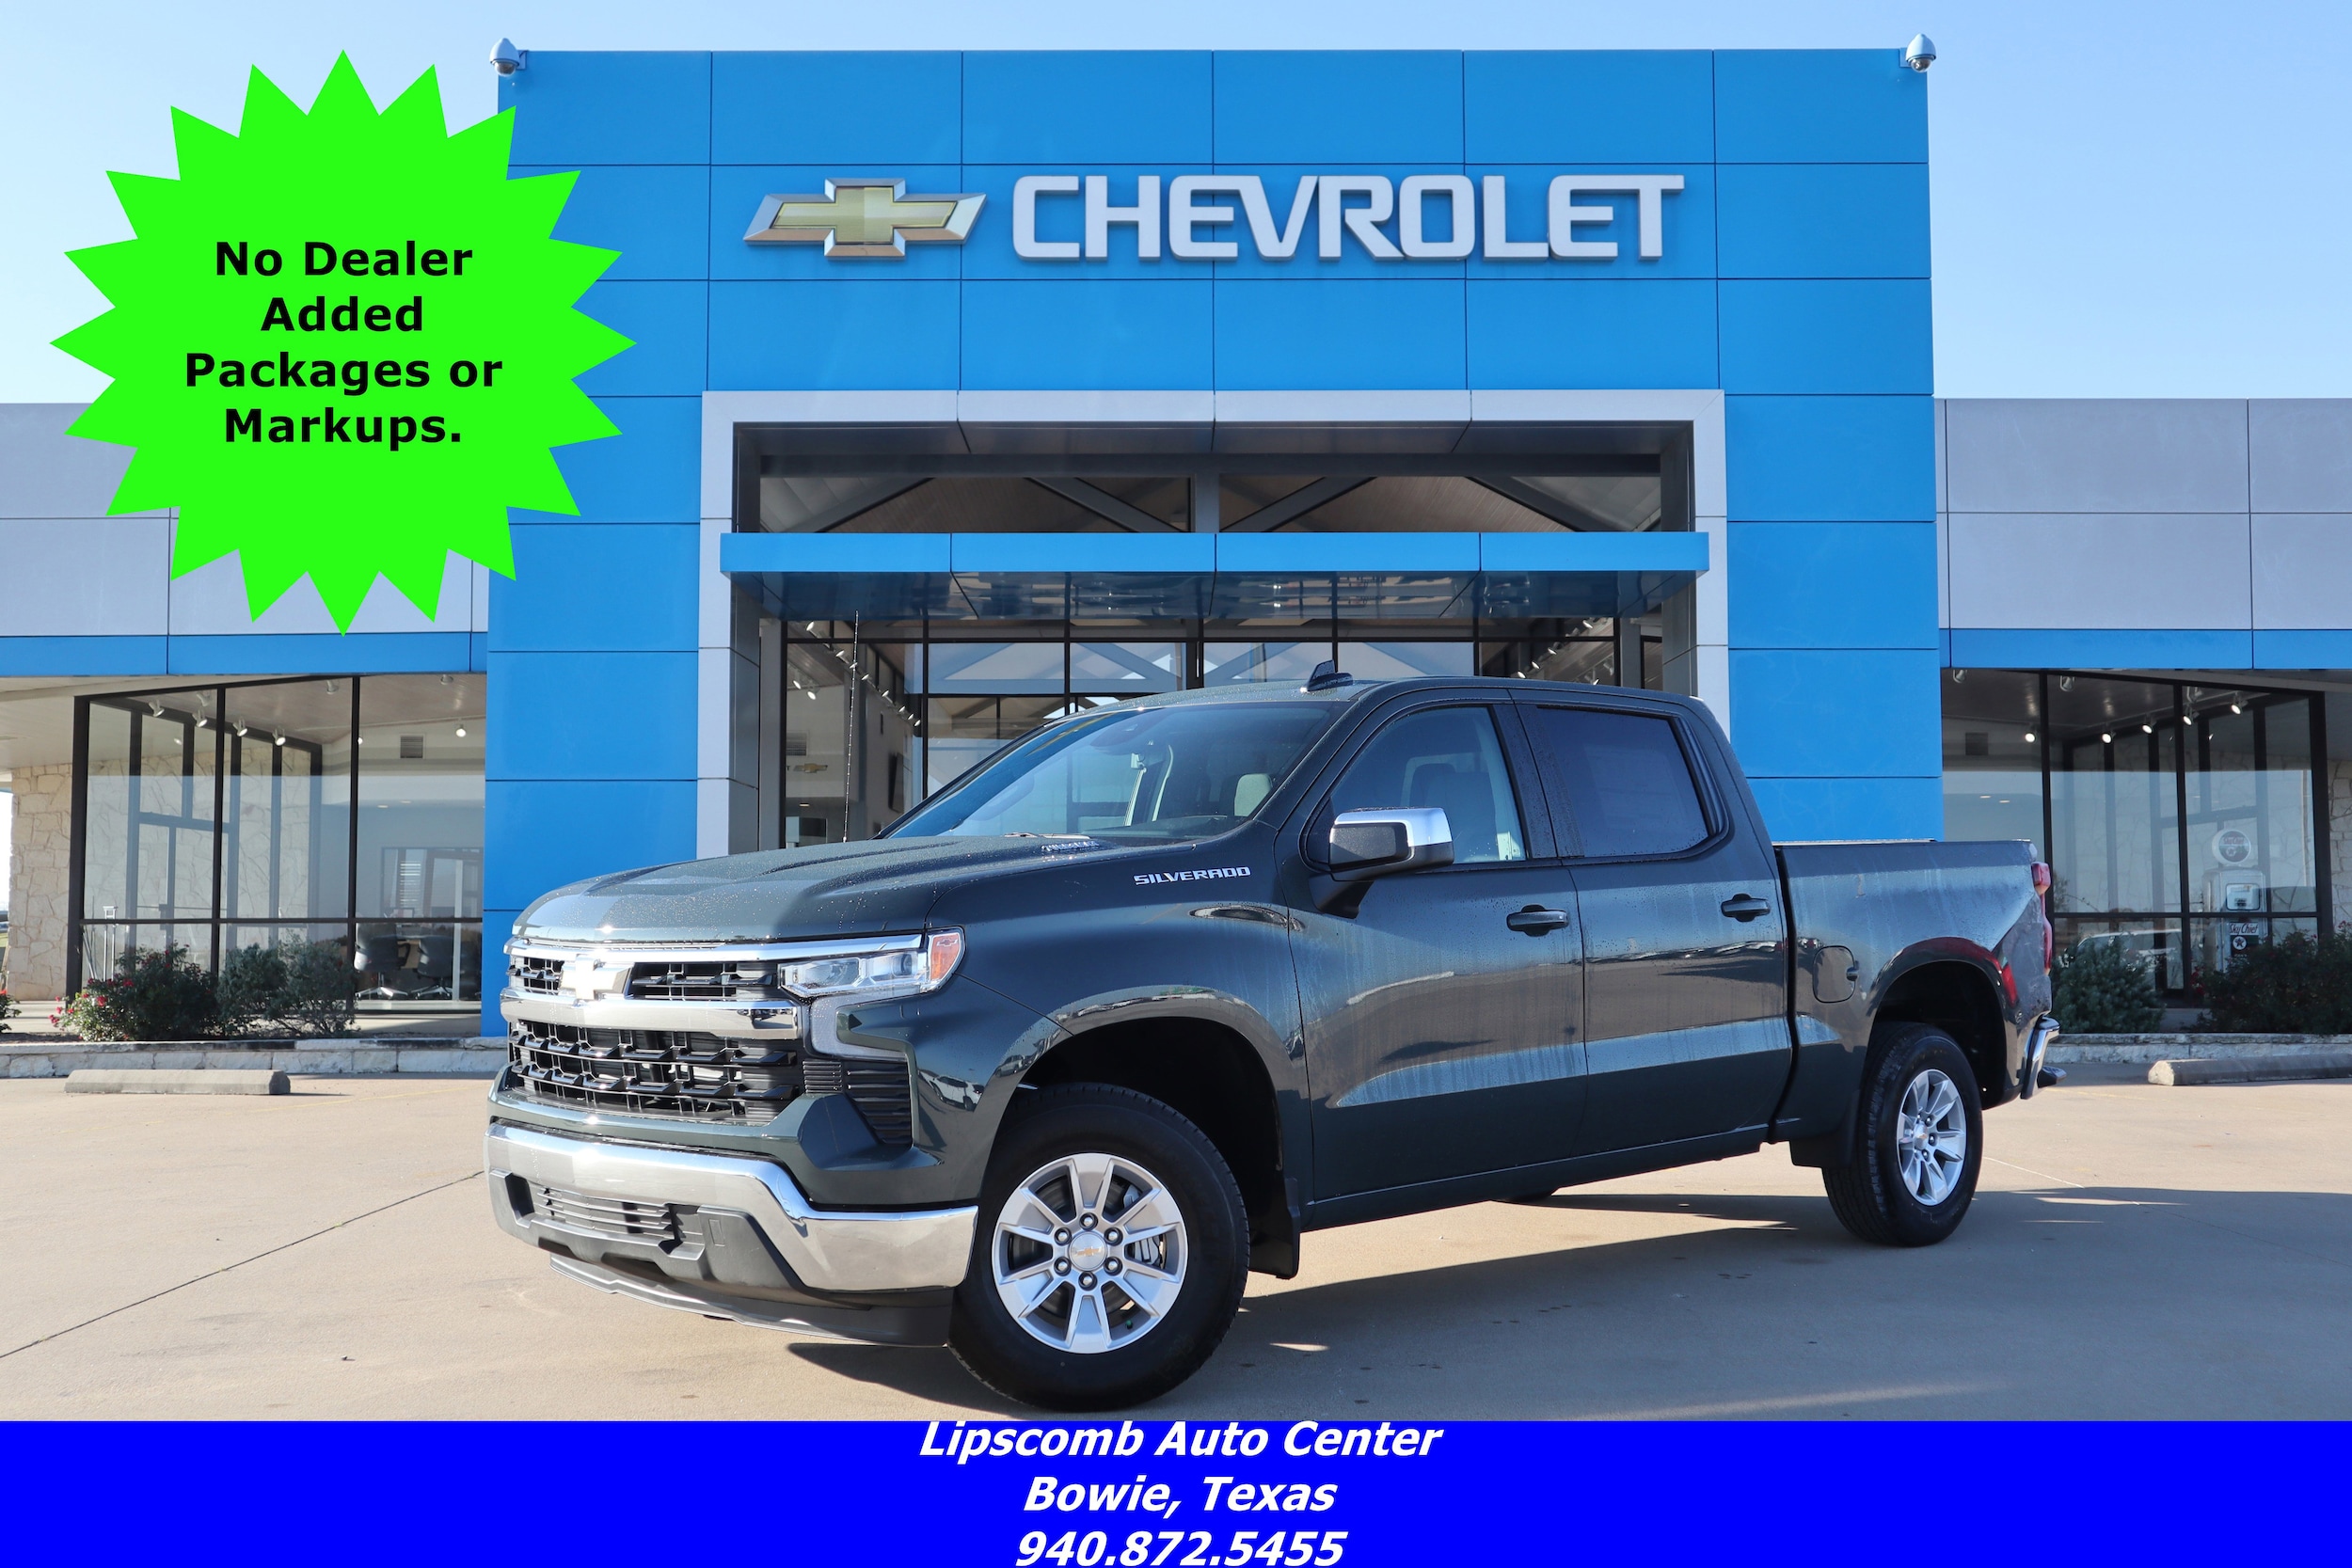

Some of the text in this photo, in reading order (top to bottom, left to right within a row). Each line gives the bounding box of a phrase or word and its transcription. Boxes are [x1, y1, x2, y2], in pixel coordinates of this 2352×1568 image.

[1013, 175, 1685, 261] CHEVROLET
[1133, 866, 1251, 886] SILVERADO
[2229, 923, 2259, 936] Sky Chief
